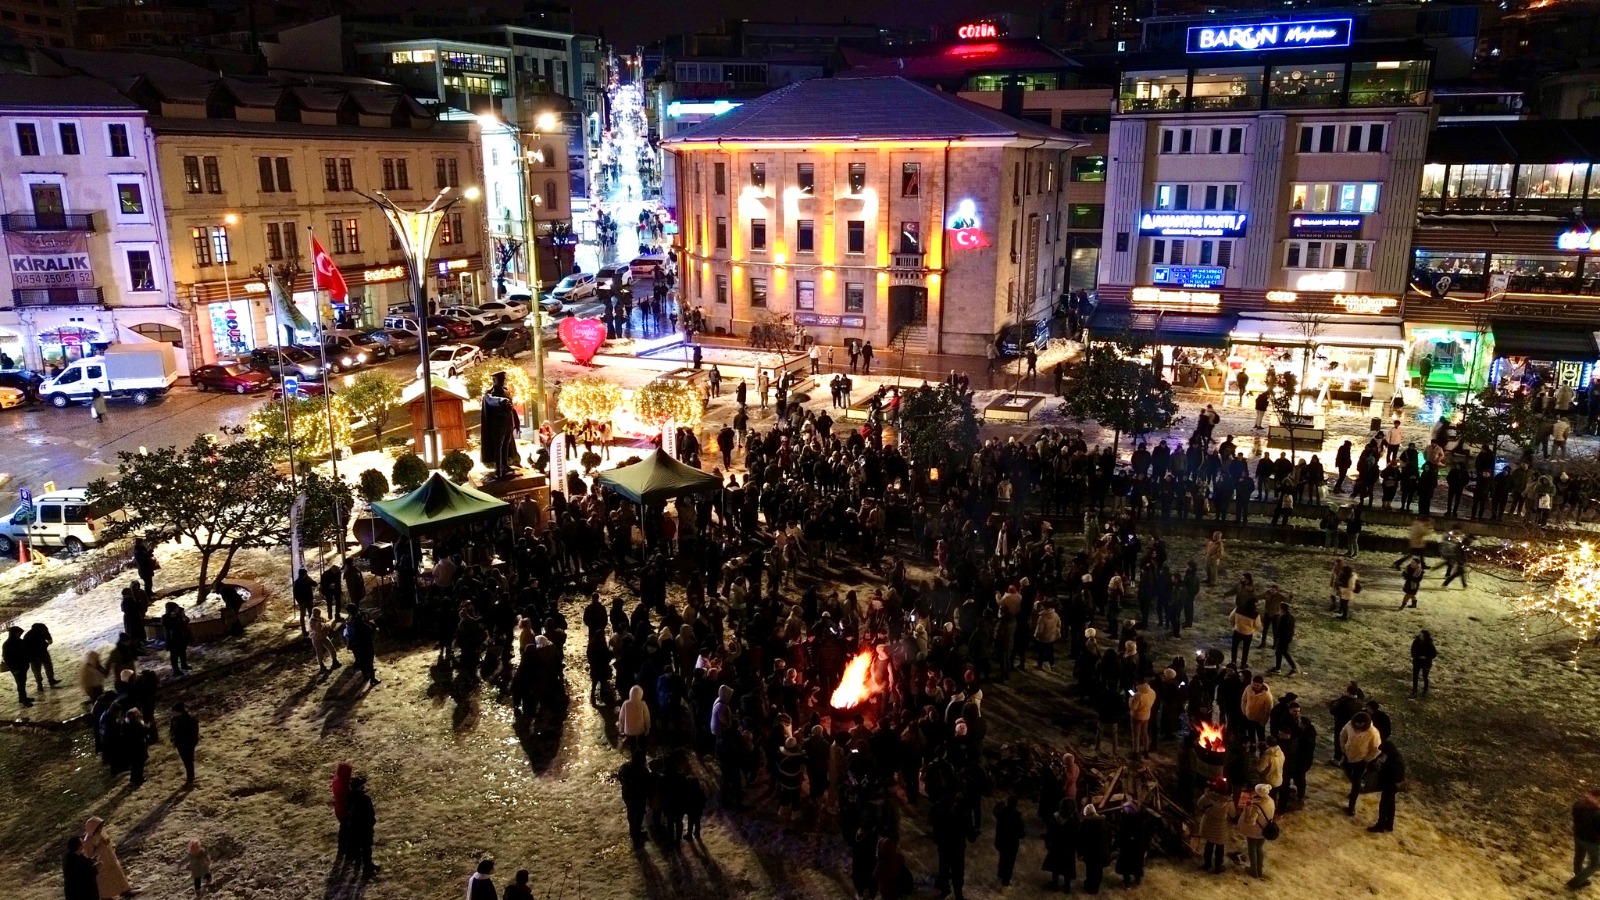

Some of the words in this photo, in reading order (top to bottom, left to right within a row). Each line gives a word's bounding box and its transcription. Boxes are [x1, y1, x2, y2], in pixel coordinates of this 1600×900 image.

[959, 24, 996, 38] ÇÖZÜM
[1200, 26, 1278, 49] BARON
[13, 256, 89, 271] KİRALIK
[16, 275, 41, 284] 0454
[43, 274, 62, 283] 250
[65, 273, 76, 283] 51
[80, 272, 91, 282] 52
